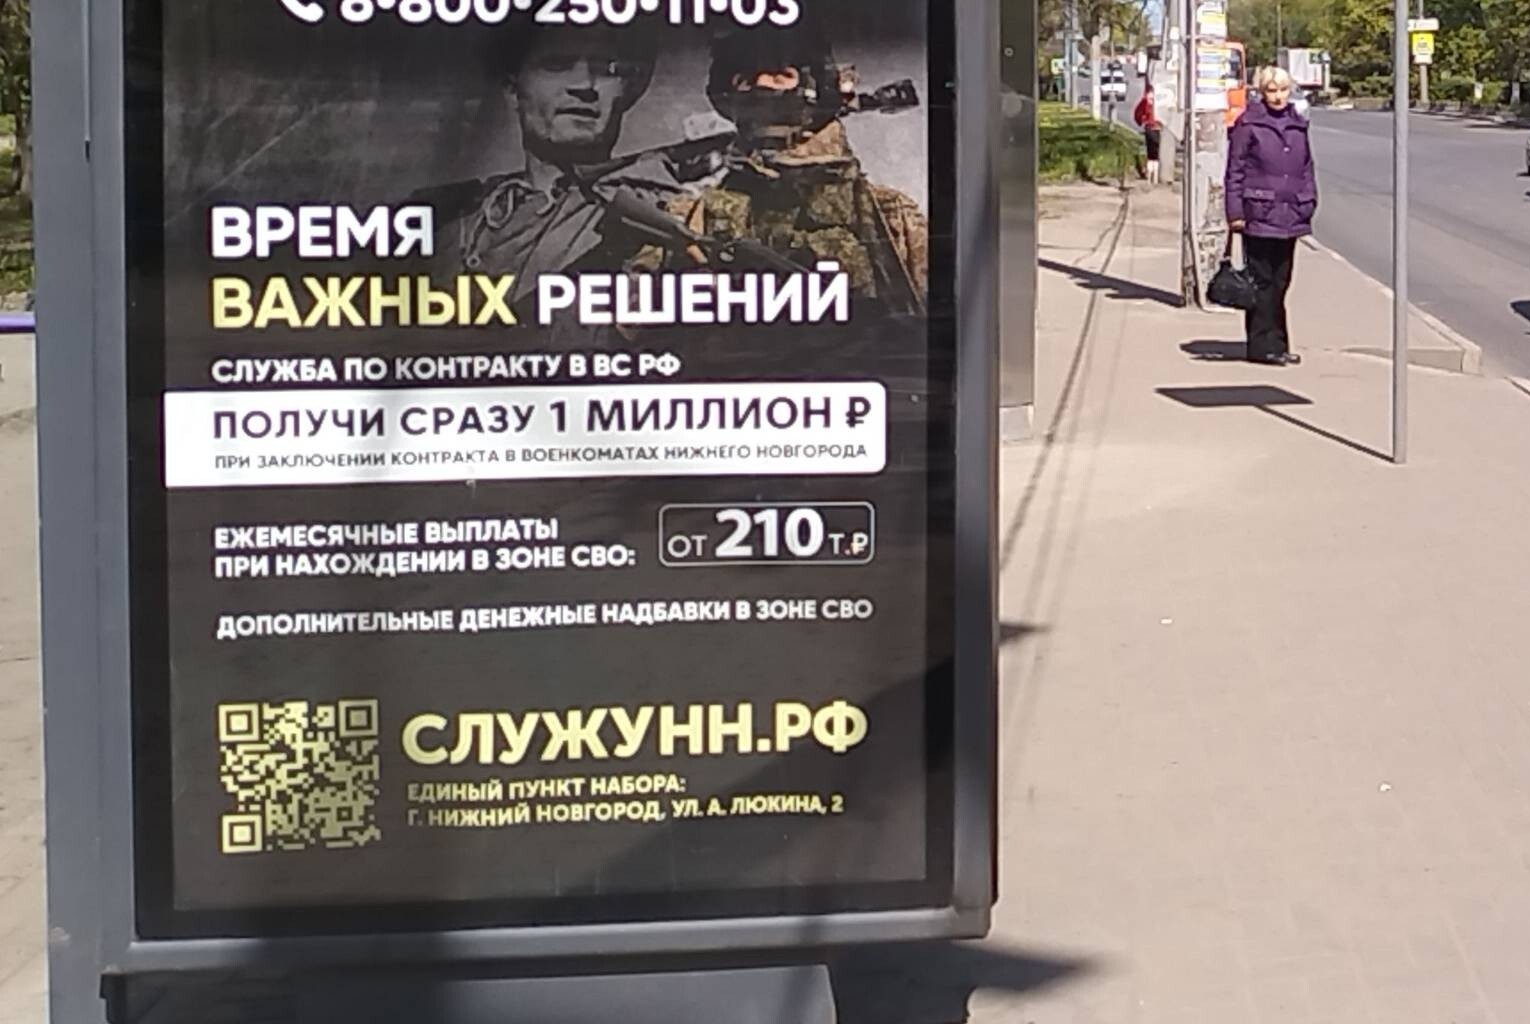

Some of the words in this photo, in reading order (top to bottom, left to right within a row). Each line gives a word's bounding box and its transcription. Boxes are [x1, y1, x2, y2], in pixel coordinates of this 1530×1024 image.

[211, 205, 434, 258] ВРЕМЯ
[212, 274, 517, 329] ВАЖНЫХ
[537, 258, 849, 325] РЕШЕНИЙ
[211, 358, 338, 383] СЛУЖБА
[343, 357, 388, 381] ПО
[395, 354, 563, 380] КОНТРАКТУ
[569, 353, 587, 377] В
[593, 353, 632, 377] ВС
[638, 352, 681, 376] РФ
[213, 407, 385, 439] ПОЛУЧИ
[399, 404, 534, 436] СРАЗУ
[549, 400, 566, 433] 1
[586, 396, 831, 432] МИЛЛИОН
[215, 455, 251, 469] ПРИ
[258, 452, 386, 469] ЗАКЛЮЧЕНИИ
[390, 449, 500, 466] КОНТРАКТА
[505, 449, 516, 462] В
[521, 446, 659, 462] ВОЕНКОМАТАХ
[663, 444, 751, 460] НИЖНЕГО
[756, 444, 867, 460] НОВГОРОДА
[214, 522, 419, 550] ЕЖЕМЕСЯЧНЫЕ
[424, 518, 558, 544] ВЫПЛАТЫ
[715, 507, 824, 558] 210
[214, 555, 270, 578] ПРИ
[275, 549, 466, 577] НАХОЖДЕНИИ
[471, 548, 490, 571] В
[495, 545, 566, 570] ЗОНЕ
[571, 544, 636, 567] СВО:
[216, 609, 454, 640] ДОПОЛНИТЕЛЬНЫЕ
[458, 603, 597, 633] ДЕНЕЖНЫЕ
[601, 600, 731, 626] НАДБАВКИ
[735, 600, 751, 620] В
[756, 599, 817, 620] ЗОНЕ
[821, 599, 873, 619] СВО
[402, 700, 867, 765] СЛУЖУНН.РФ
[409, 779, 503, 803] ЕДИНЫЙ
[508, 777, 586, 800] ПУНКТ
[590, 774, 686, 796] НАБОРА:
[407, 808, 423, 827] Г.
[429, 799, 531, 827] НИЖНИЙ
[535, 800, 666, 822] НОВГОРОД,
[671, 798, 704, 818] УЛ.
[706, 797, 727, 816] А.
[729, 795, 827, 815] ЛЮКИНА,
[831, 794, 844, 813] 2
